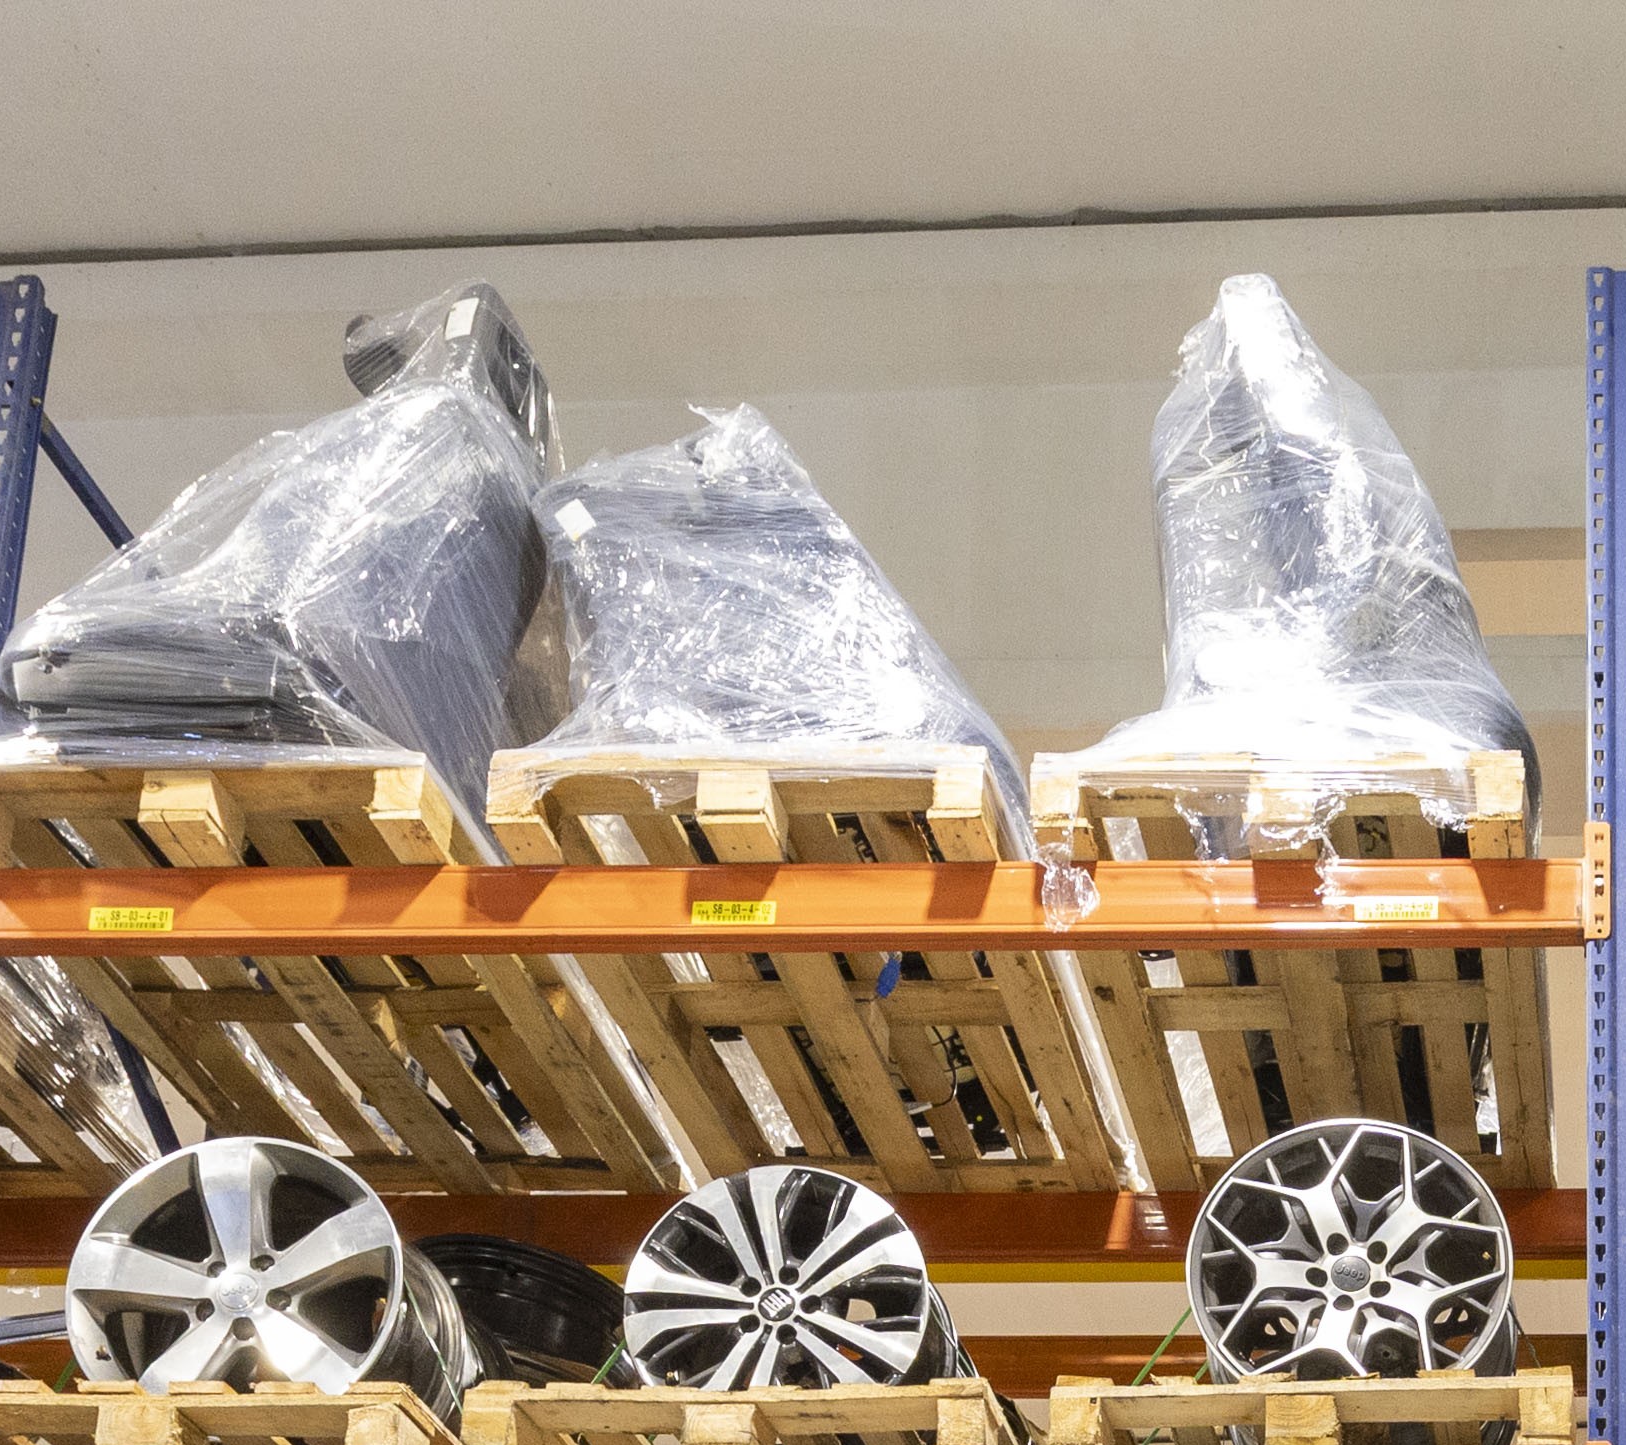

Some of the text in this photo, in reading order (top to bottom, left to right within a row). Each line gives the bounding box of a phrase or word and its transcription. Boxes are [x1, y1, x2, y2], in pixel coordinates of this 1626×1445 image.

[110, 910, 169, 921] SB-03-4-01
[712, 903, 772, 915] SB-03-4-02
[1334, 1263, 1366, 1283] Jeep
[760, 1288, 793, 1317] FIAT
